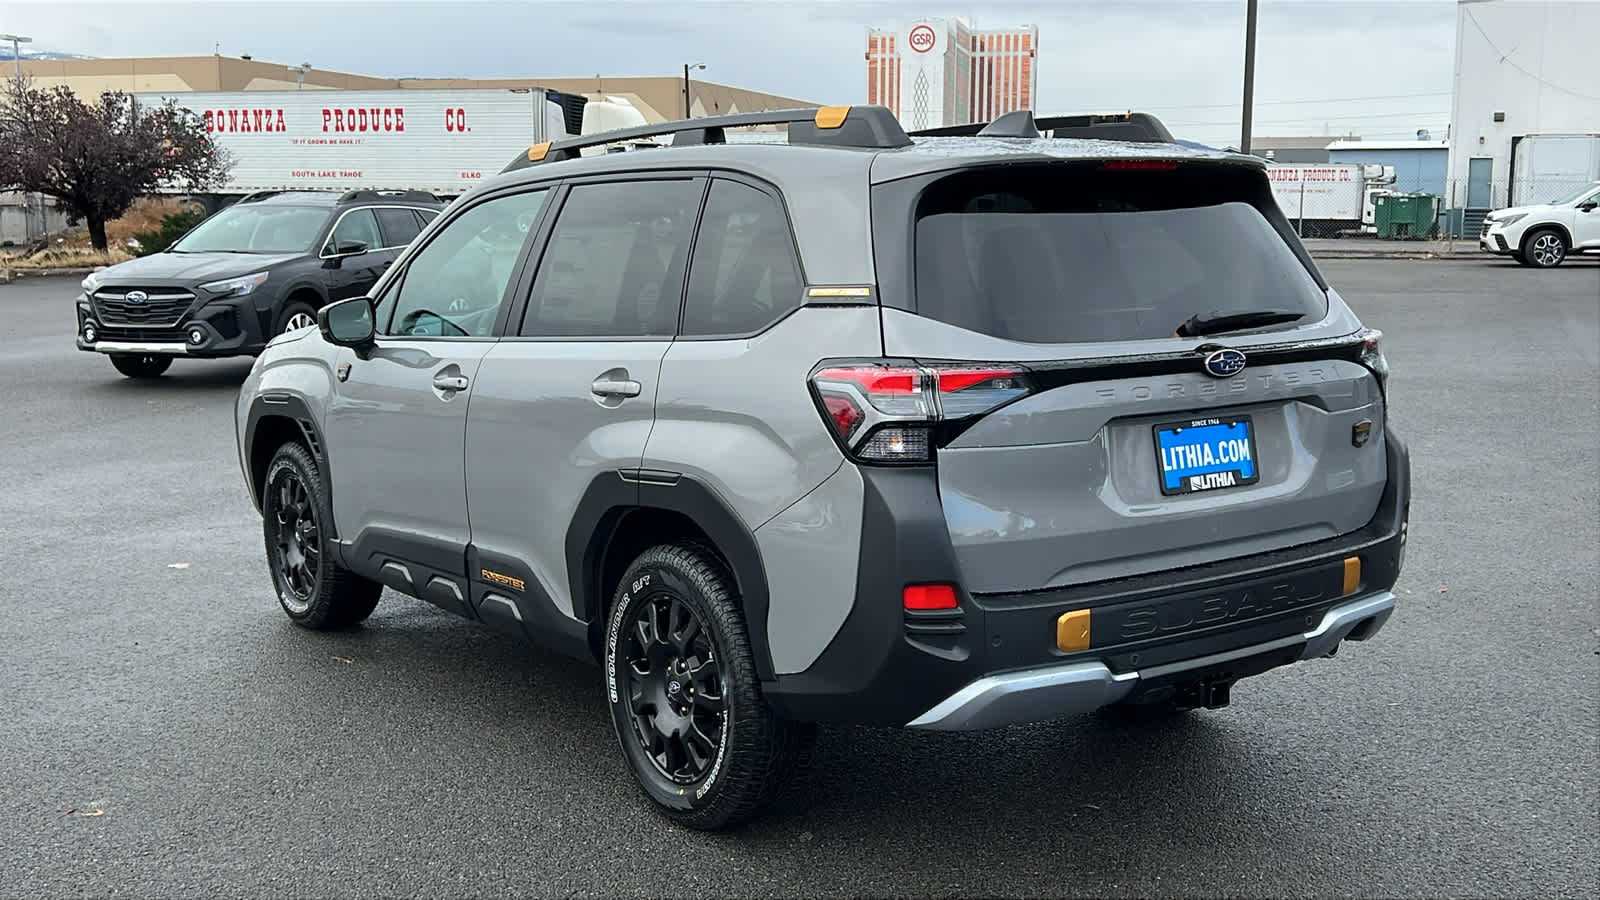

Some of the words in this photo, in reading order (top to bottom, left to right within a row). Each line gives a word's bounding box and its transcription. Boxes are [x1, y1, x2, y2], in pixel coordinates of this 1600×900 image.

[912, 33, 932, 46] GSR
[204, 109, 287, 133] BONANZA
[322, 108, 404, 132] PRODUCE
[445, 108, 471, 132] CO.
[1303, 169, 1336, 181] PRODUCE
[1339, 169, 1352, 181] CO.
[1191, 419, 1207, 428] SINCE
[1161, 438, 1251, 471] LITHIA.COM
[1201, 471, 1236, 489] LITHIA
